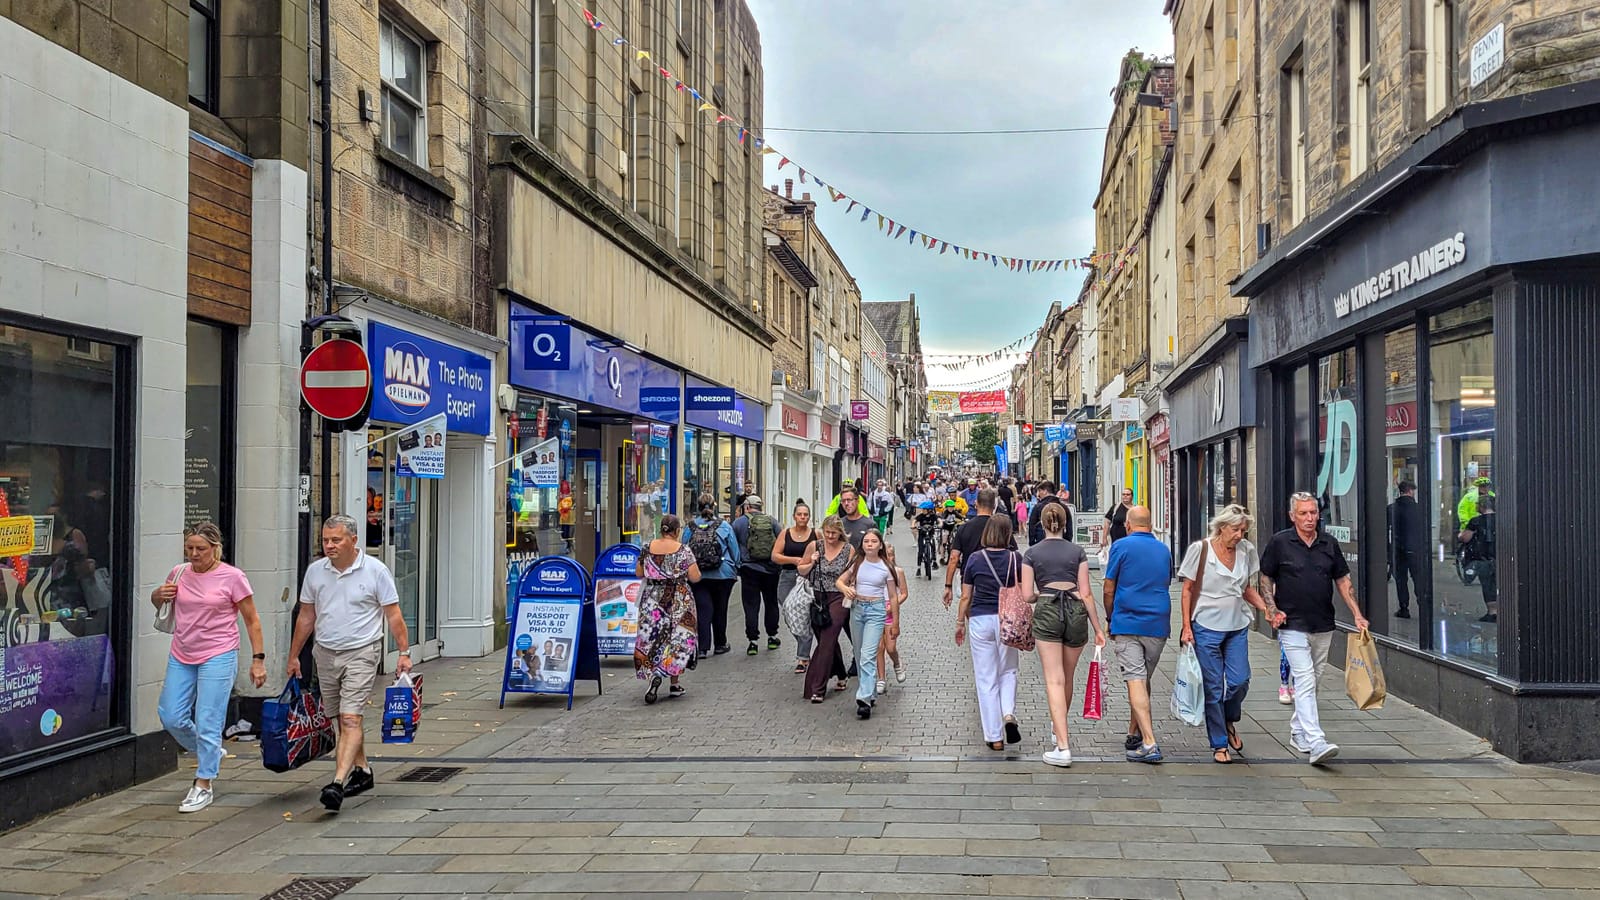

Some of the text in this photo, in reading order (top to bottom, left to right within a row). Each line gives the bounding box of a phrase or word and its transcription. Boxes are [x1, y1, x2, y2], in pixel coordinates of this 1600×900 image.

[1473, 29, 1500, 61] PENNY
[1472, 51, 1501, 84] STREET
[1350, 232, 1466, 312] KING OF TRAINERS
[385, 346, 430, 387] MAX
[438, 360, 483, 391] The Photo
[388, 386, 427, 401] SPIELMANN
[693, 394, 731, 402] shoezone
[1212, 365, 1225, 426] JD
[447, 393, 476, 421] Expert
[1317, 400, 1357, 498] JD
[613, 553, 634, 561] MAX
[540, 569, 566, 578] MAX
[527, 612, 570, 620] PASSPORT
[529, 626, 564, 634] PHOTOS
[5, 671, 43, 692] WELCOME
[389, 701, 409, 711] M&S
